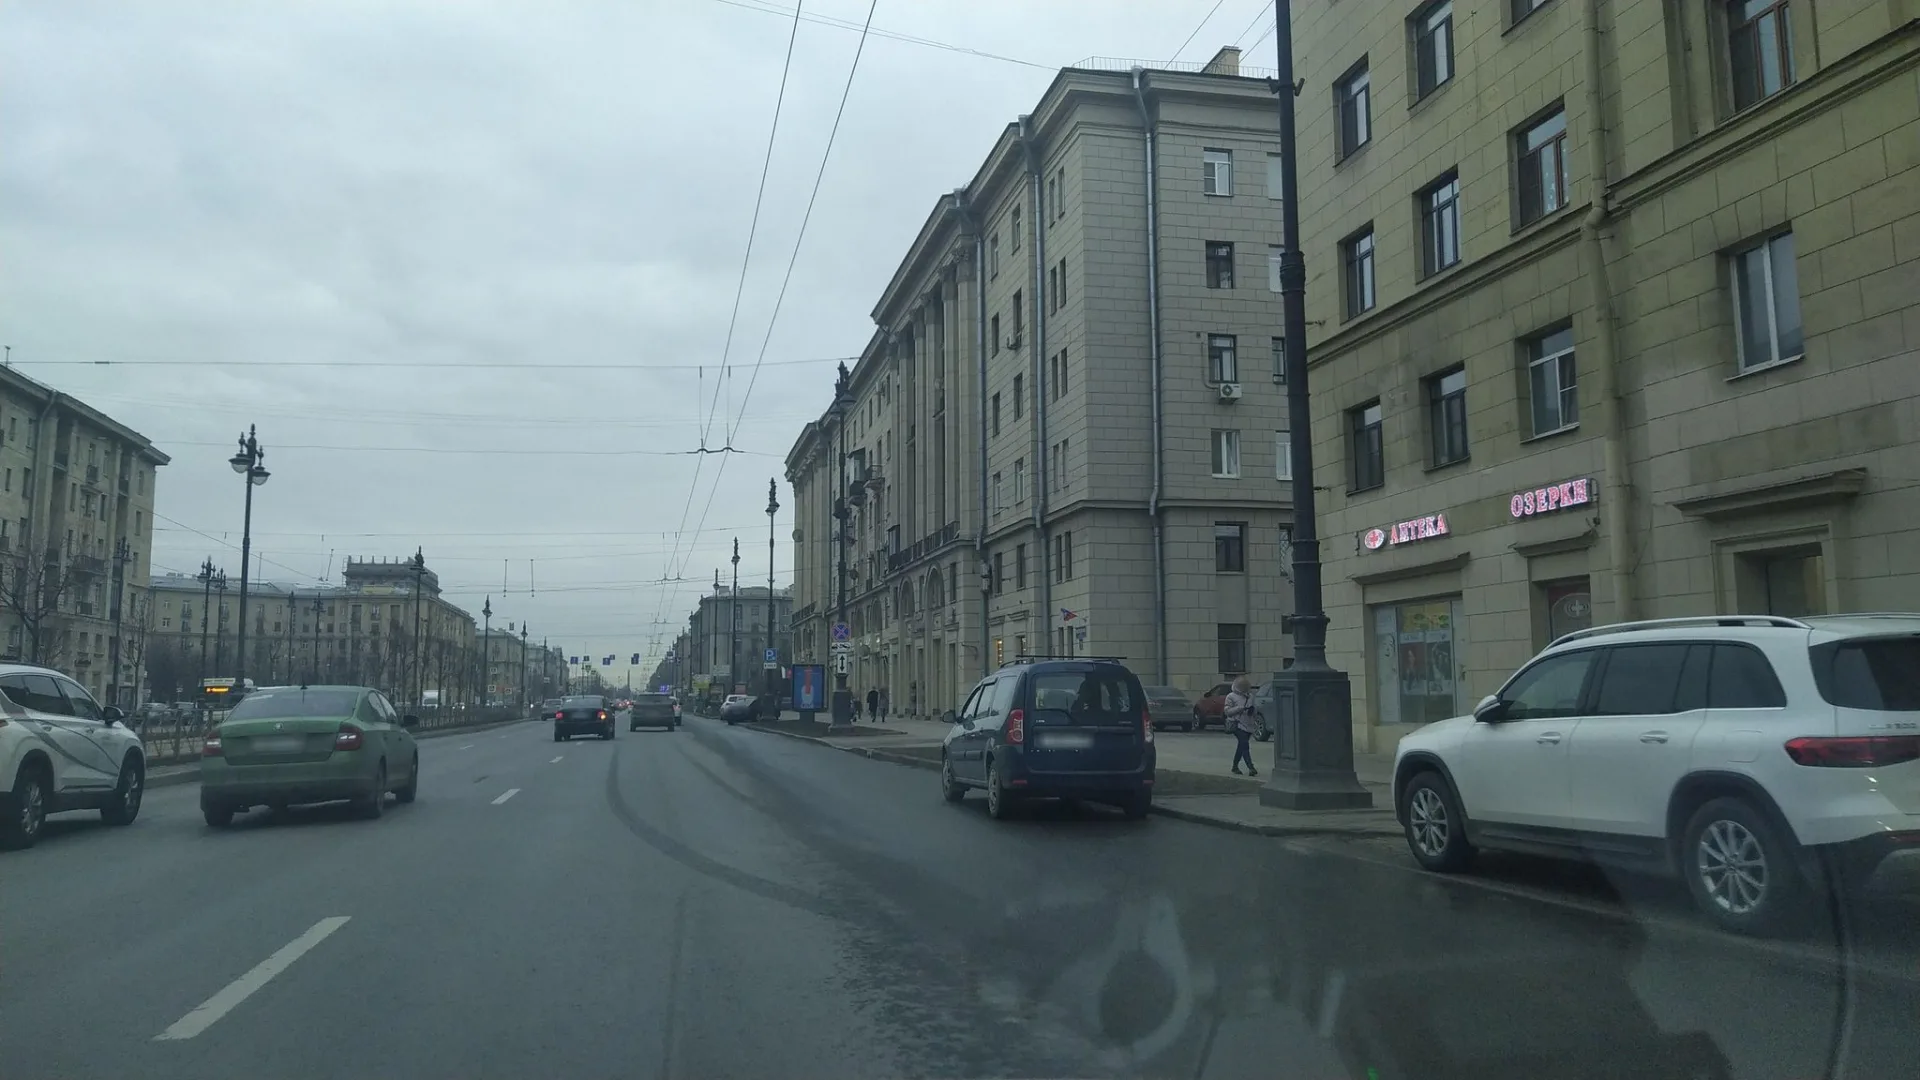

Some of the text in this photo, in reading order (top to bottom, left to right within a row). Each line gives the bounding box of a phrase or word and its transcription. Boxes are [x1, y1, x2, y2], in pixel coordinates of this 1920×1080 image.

[1510, 478, 1588, 518] ОЗЕРКИ
[1389, 513, 1448, 545] АПТЕКА
[766, 649, 775, 661] P
